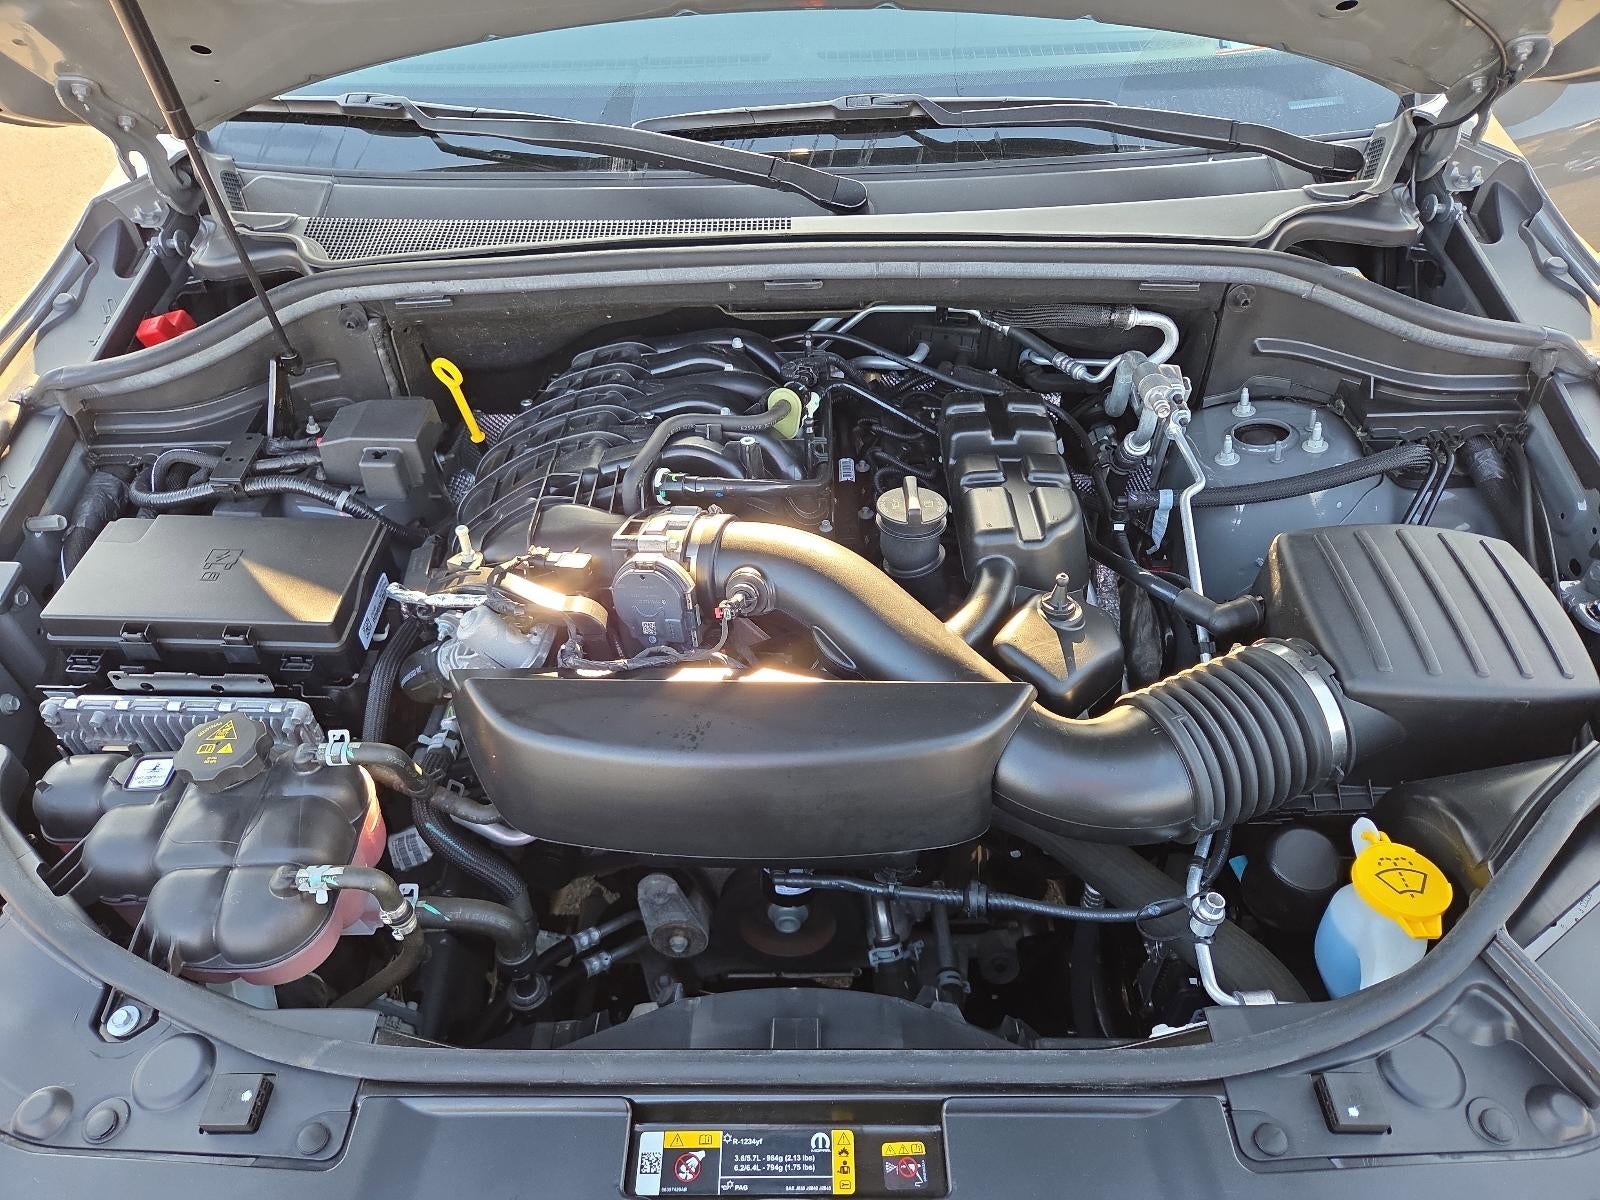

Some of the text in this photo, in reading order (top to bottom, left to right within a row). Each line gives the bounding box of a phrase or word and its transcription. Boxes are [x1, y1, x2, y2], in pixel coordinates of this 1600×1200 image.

[732, 1138, 763, 1146] R-1234yf
[734, 1154, 761, 1162] 3.6/5.7L
[784, 1154, 801, 1163] (2.13
[802, 1154, 815, 1163] lbs)
[734, 1164, 761, 1172] 6.2/6.4L
[766, 1164, 783, 1173] 794g
[784, 1164, 801, 1173] (1.75
[802, 1164, 815, 1173] lbs)
